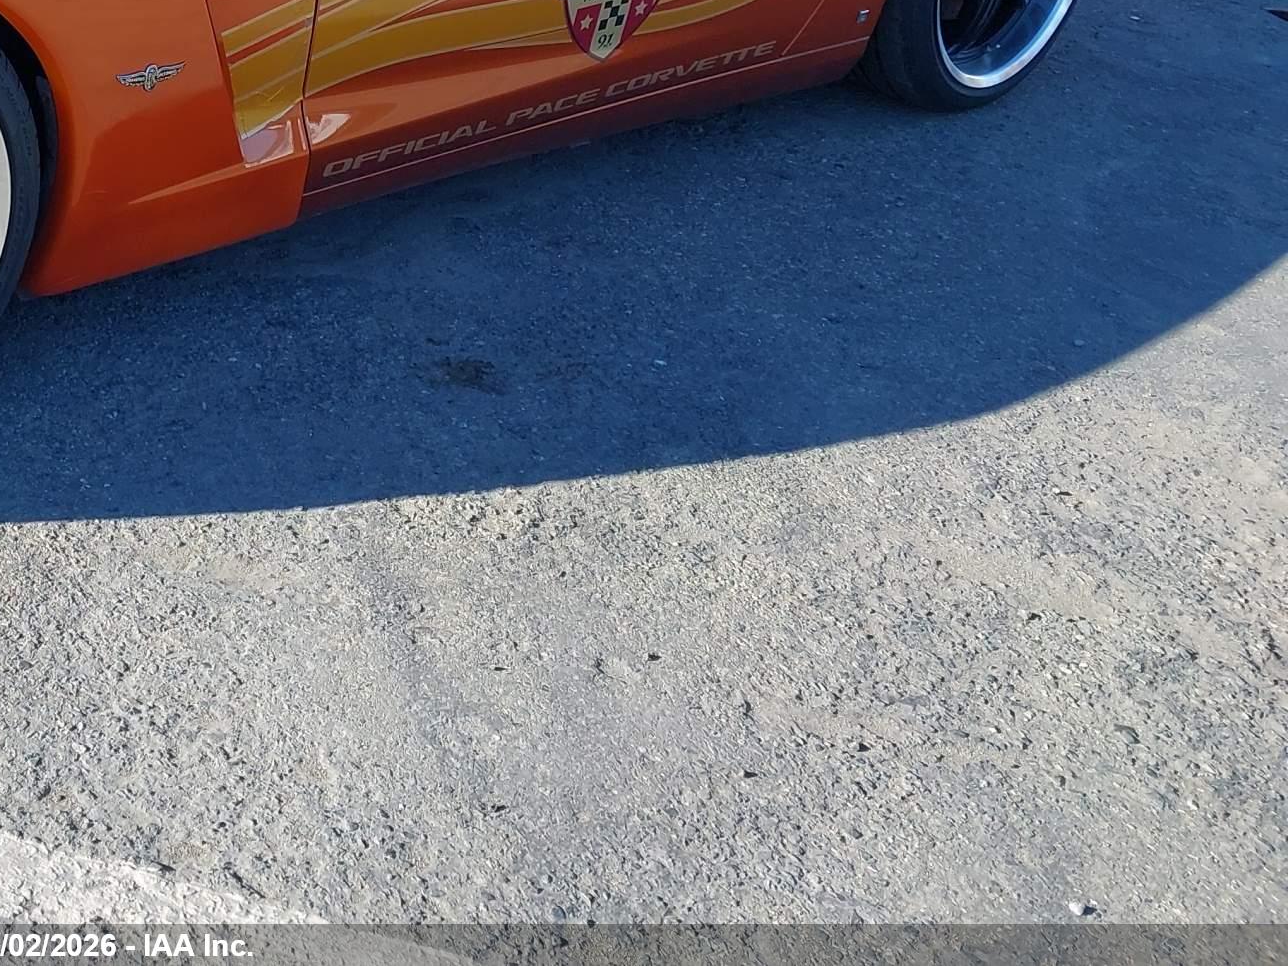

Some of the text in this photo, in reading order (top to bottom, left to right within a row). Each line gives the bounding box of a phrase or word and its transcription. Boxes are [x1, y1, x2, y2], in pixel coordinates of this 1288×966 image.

[322, 40, 777, 177] OFFICIAL PACE CORVETTE
